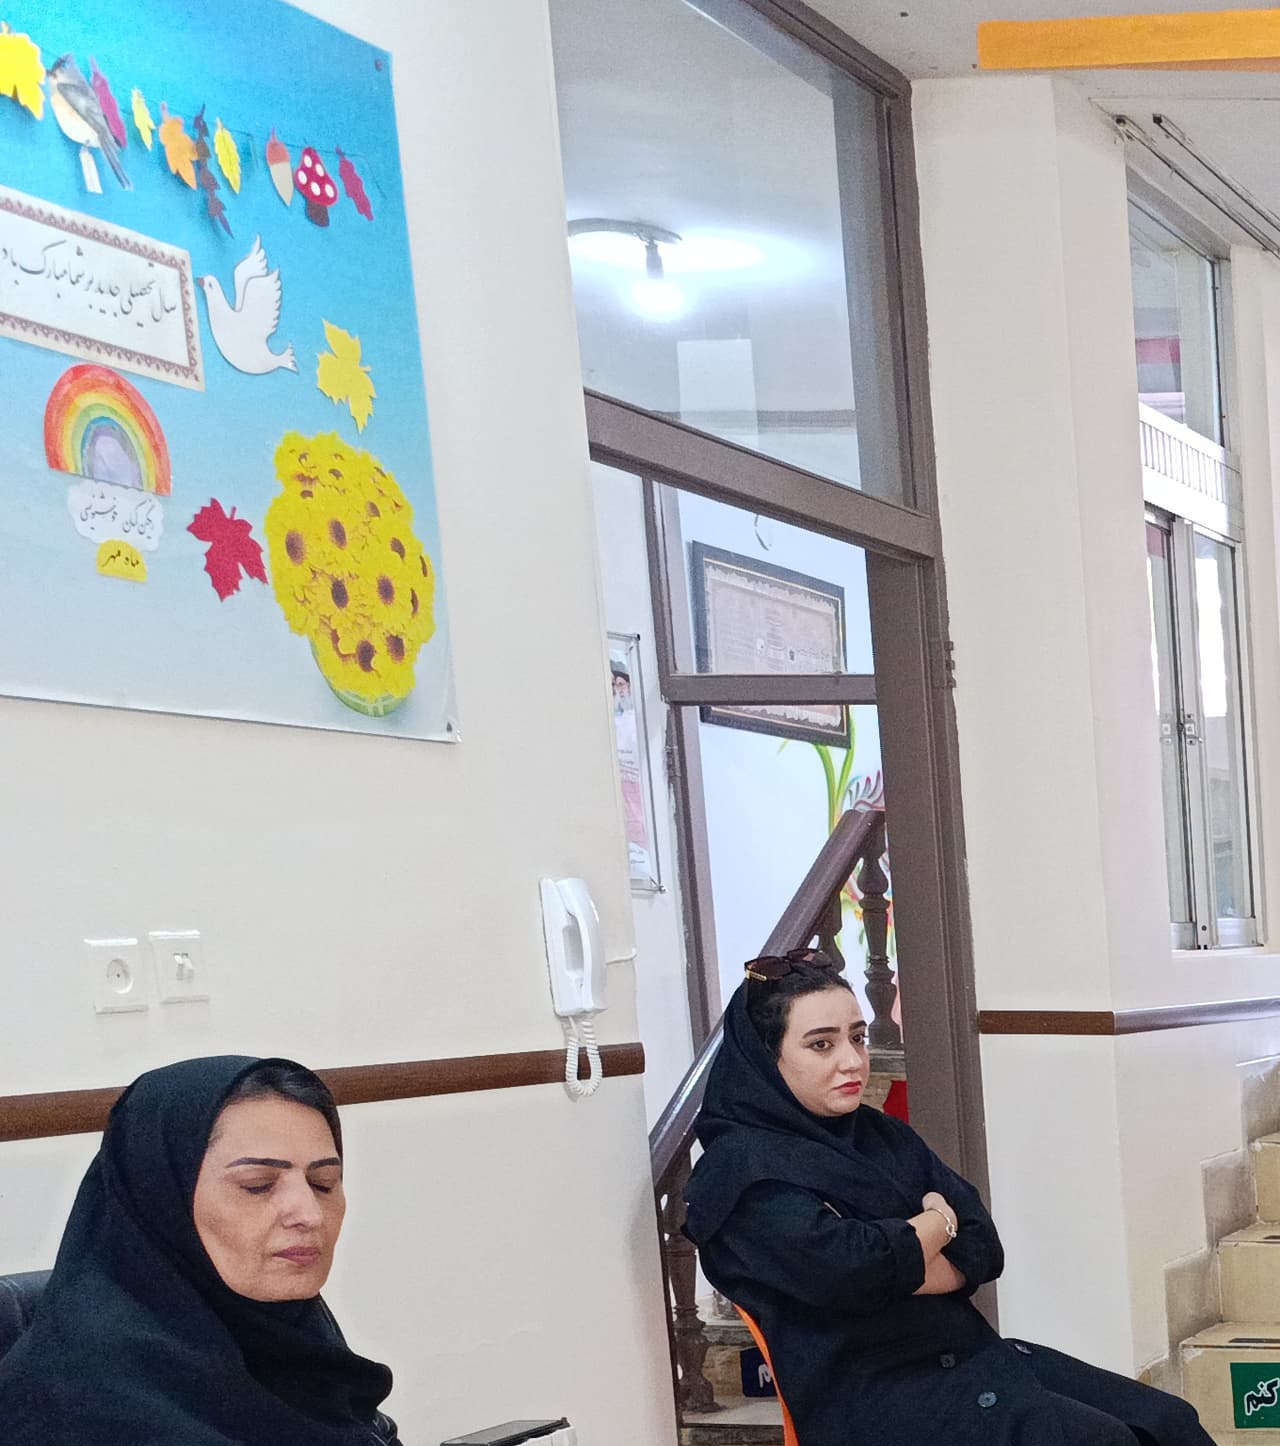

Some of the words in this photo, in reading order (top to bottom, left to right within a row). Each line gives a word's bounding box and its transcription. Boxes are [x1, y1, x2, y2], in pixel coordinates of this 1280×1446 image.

[2, 247, 20, 285] باد
[19, 238, 68, 299] مبارک
[69, 245, 86, 286] شما
[96, 278, 121, 318] جدید
[120, 262, 156, 328] تحصیلی
[151, 286, 177, 322] سال
[1244, 1376, 1280, 1416] کنم
